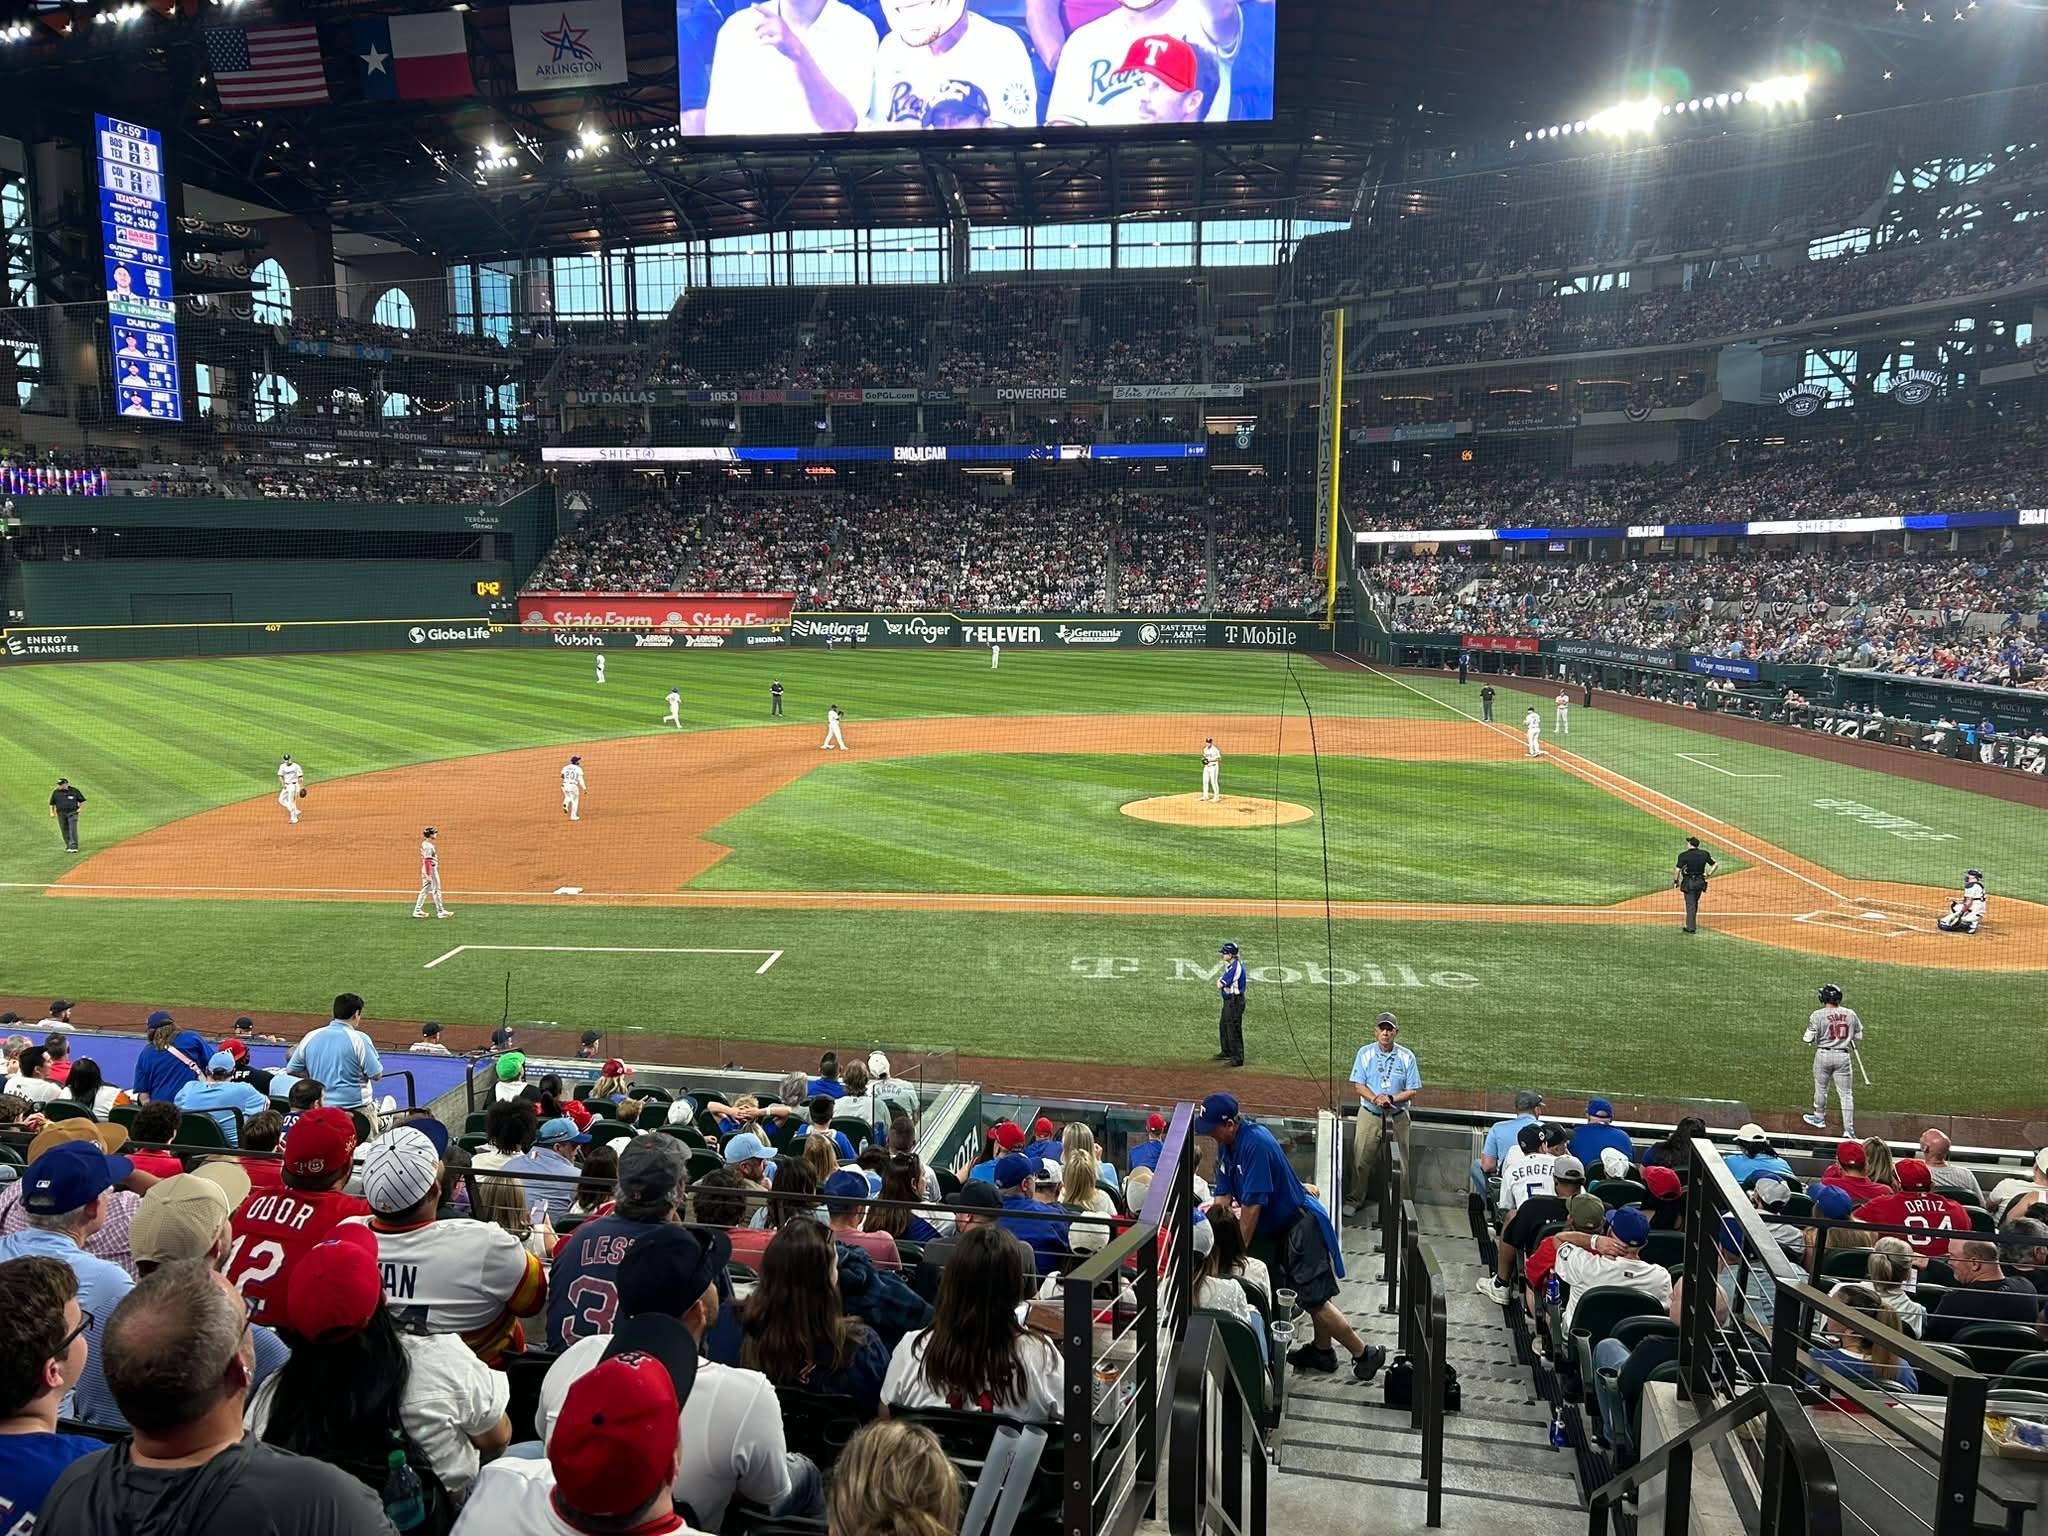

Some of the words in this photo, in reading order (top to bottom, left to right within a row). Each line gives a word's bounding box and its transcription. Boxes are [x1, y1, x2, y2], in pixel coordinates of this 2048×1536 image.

[536, 62, 601, 76] ARLINGTON
[116, 122, 140, 138] 6:59
[109, 136, 123, 148] BOS
[110, 147, 123, 160] TEX
[112, 165, 125, 178] COL
[115, 177, 123, 189] TB
[113, 211, 157, 231] $32,310
[127, 318, 146, 328] DUE
[147, 322, 161, 331] UP
[6, 340, 39, 350] RESORTS
[1887, 374, 1908, 391] JACK
[1908, 367, 1943, 386] DANIEL'S
[579, 392, 602, 403] UT
[604, 391, 656, 403] DALLAS
[709, 391, 738, 402] 105.3
[865, 391, 915, 400] GoPGL.com
[997, 388, 1067, 400] POWERADE
[1114, 385, 1142, 398] Blue
[1778, 388, 1797, 404] JACK
[1798, 383, 1828, 400] DANIEL'S
[229, 423, 282, 434] PRIORITY
[287, 425, 317, 436] GOLD
[336, 428, 380, 439] HARGROVE
[393, 431, 428, 441] ROOFING
[894, 447, 925, 460] EMOJI
[926, 447, 946, 460] CAM
[1318, 483, 1329, 545] FARE
[265, 624, 281, 632] 407
[427, 628, 467, 641] Globe
[467, 626, 491, 640] Life
[489, 625, 503, 633] 410
[904, 617, 950, 643] Kroger
[962, 626, 1042, 643] 7-ELEVEN
[1074, 627, 1121, 637] Germania
[27, 635, 67, 645] ENERGY
[554, 633, 604, 647] Kubota
[1173, 631, 1193, 639] A&M
[1242, 626, 1297, 645] Mobile
[28, 644, 79, 653] TRANSFER
[1557, 645, 1588, 654] American
[1646, 655, 1668, 665] American
[1166, 957, 1481, 989] Mobile
[1828, 1024, 1850, 1041] 10
[246, 1195, 314, 1230] ODOR
[1904, 1199, 1946, 1214] ORTIZ
